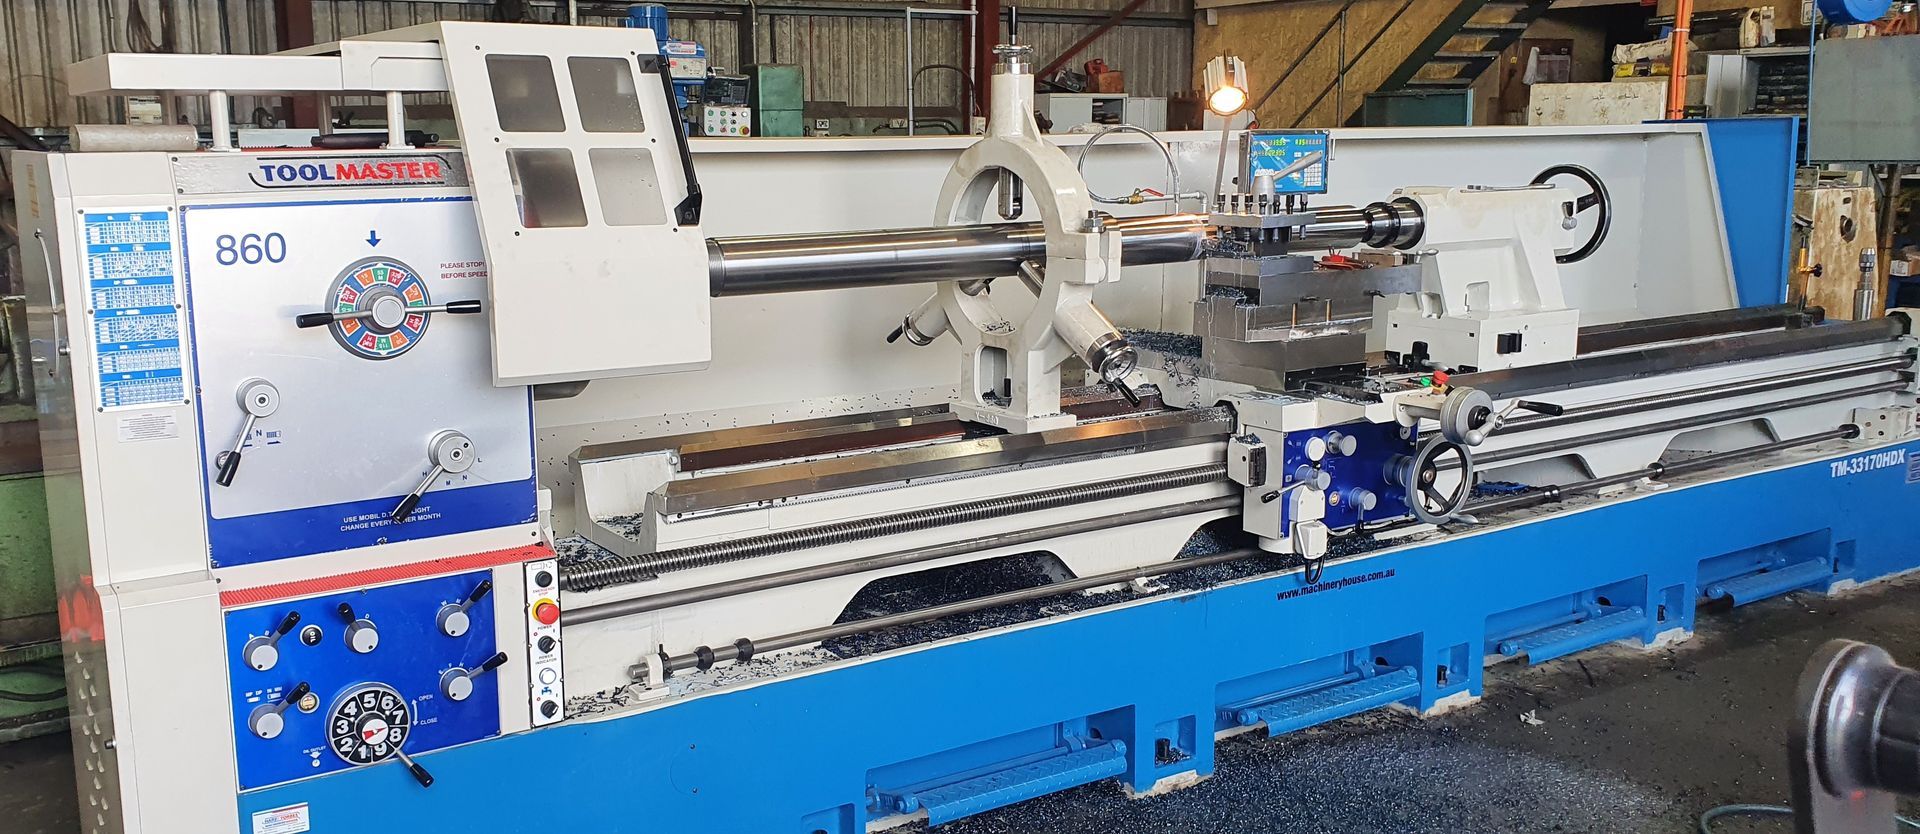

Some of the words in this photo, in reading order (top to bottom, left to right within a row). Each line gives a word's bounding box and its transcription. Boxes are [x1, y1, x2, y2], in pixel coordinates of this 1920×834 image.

[259, 161, 444, 182] TOOLMASTER
[215, 232, 287, 266] 860
[1830, 448, 1906, 478] TM-33170HDX
[340, 523, 370, 532] CHANGE
[370, 519, 392, 528] EVERY
[418, 512, 441, 521] MONTH
[359, 514, 381, 522] MOBIL
[1276, 568, 1395, 600] www.machineryhouse.com.au
[363, 693, 377, 708] 5
[381, 695, 394, 710] 6
[418, 694, 433, 702] OPEN
[344, 701, 357, 716] 4
[392, 710, 404, 724] 7
[420, 717, 438, 726] CLOSE
[336, 720, 349, 734] 3
[389, 728, 401, 743] 8
[340, 738, 353, 752] 2
[358, 746, 367, 759] 1
[375, 742, 387, 756] 9
